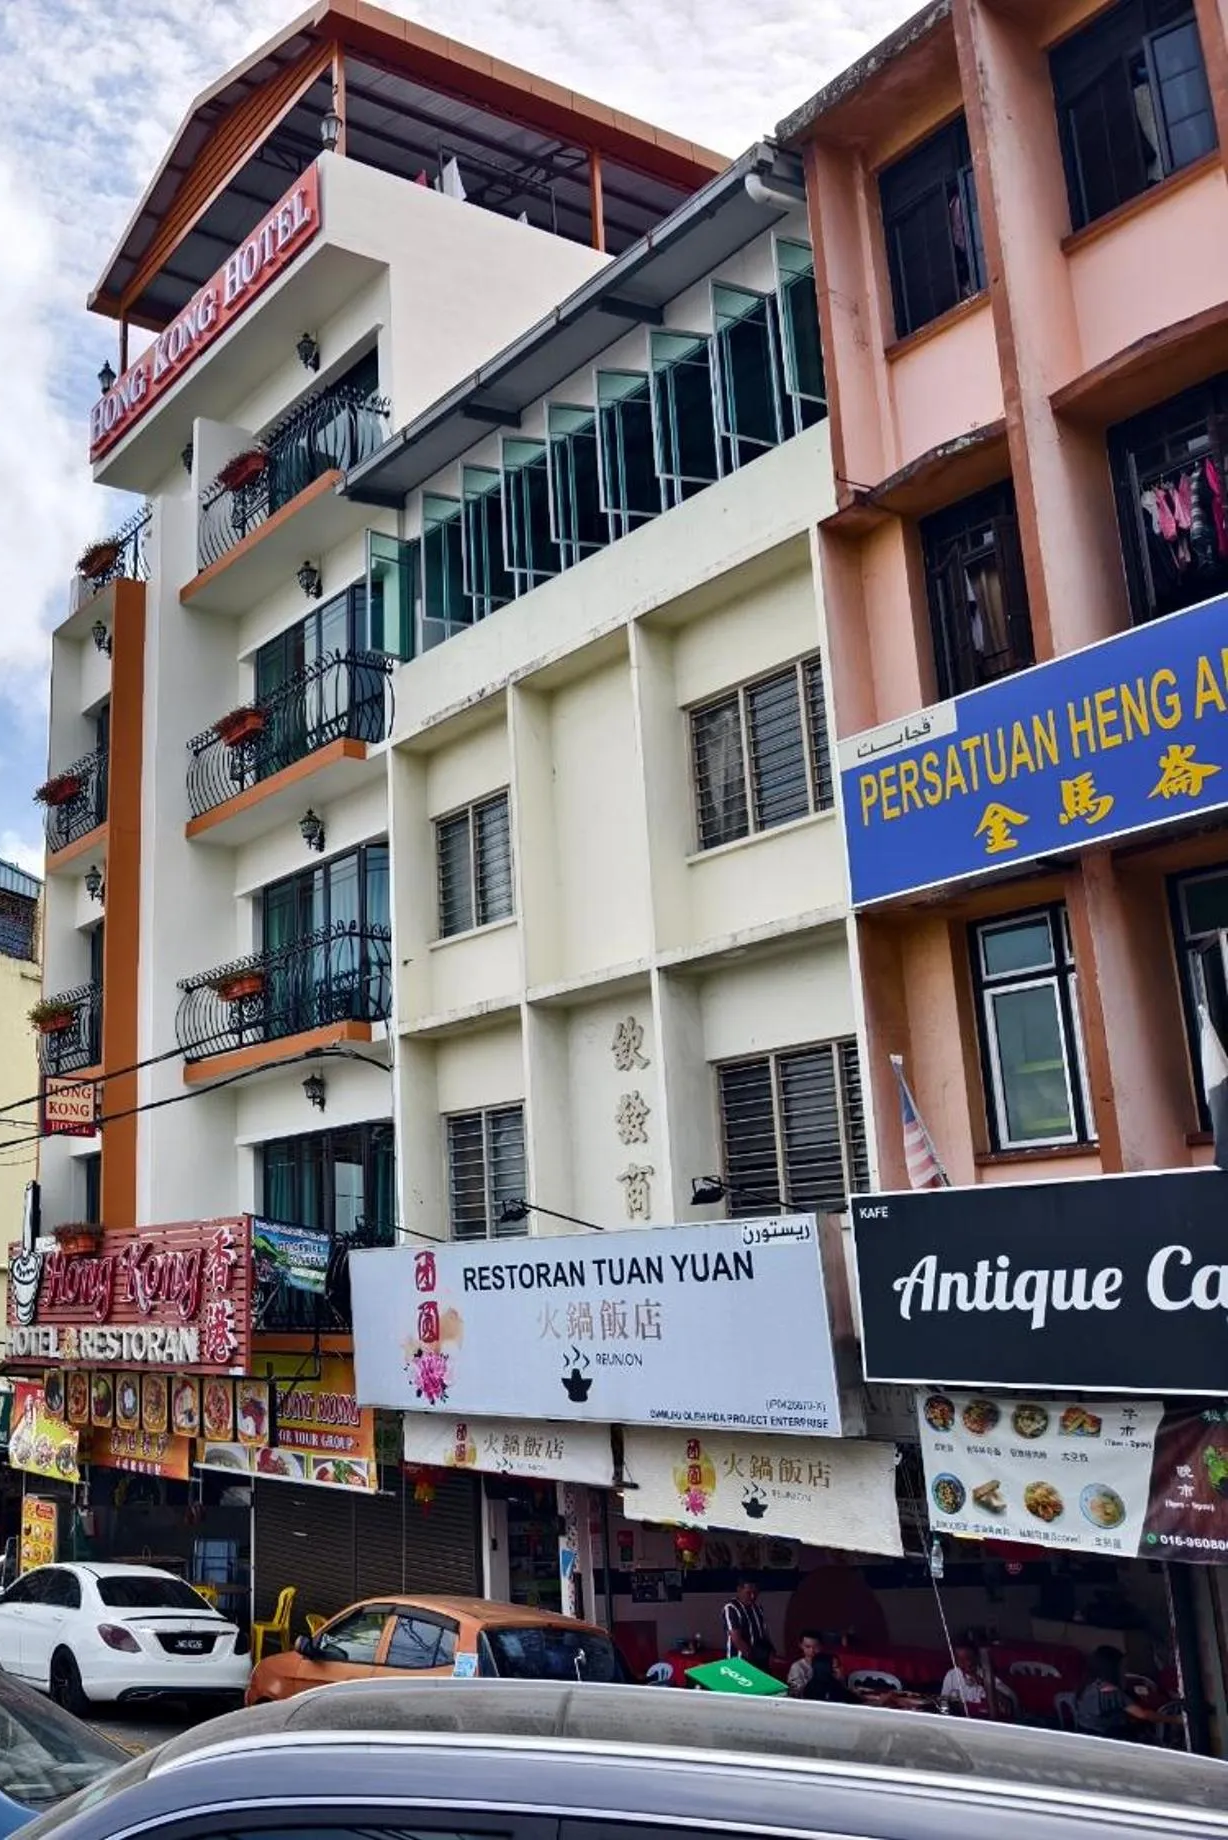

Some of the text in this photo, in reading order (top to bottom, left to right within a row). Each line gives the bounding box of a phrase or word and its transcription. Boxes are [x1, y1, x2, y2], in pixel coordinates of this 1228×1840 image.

[91, 188, 312, 446] HONG KONG HOTEL
[860, 647, 1228, 827] PERSATUAN HENG A
[48, 1084, 92, 1099] HONG
[48, 1102, 90, 1117] KONG
[859, 1206, 889, 1219] KAFE
[742, 1221, 810, 1246] ريستورن
[44, 1240, 203, 1323] Hong Kong
[463, 1250, 755, 1292] RESTORAN TUAN YUAN
[893, 1244, 1228, 1330] Antique Ca
[203, 1226, 238, 1363] 香港
[537, 1297, 663, 1341] 火鍋飯店
[7, 1326, 60, 1358] HOTEL
[80, 1326, 200, 1362] RESTORAN
[595, 1352, 643, 1367] REUNION
[727, 1412, 768, 1425] PROJECT
[770, 1415, 829, 1429] ENTERPRISE
[723, 1452, 832, 1489] 火鍋飯店
[1159, 1534, 1228, 1551] 016-96080
